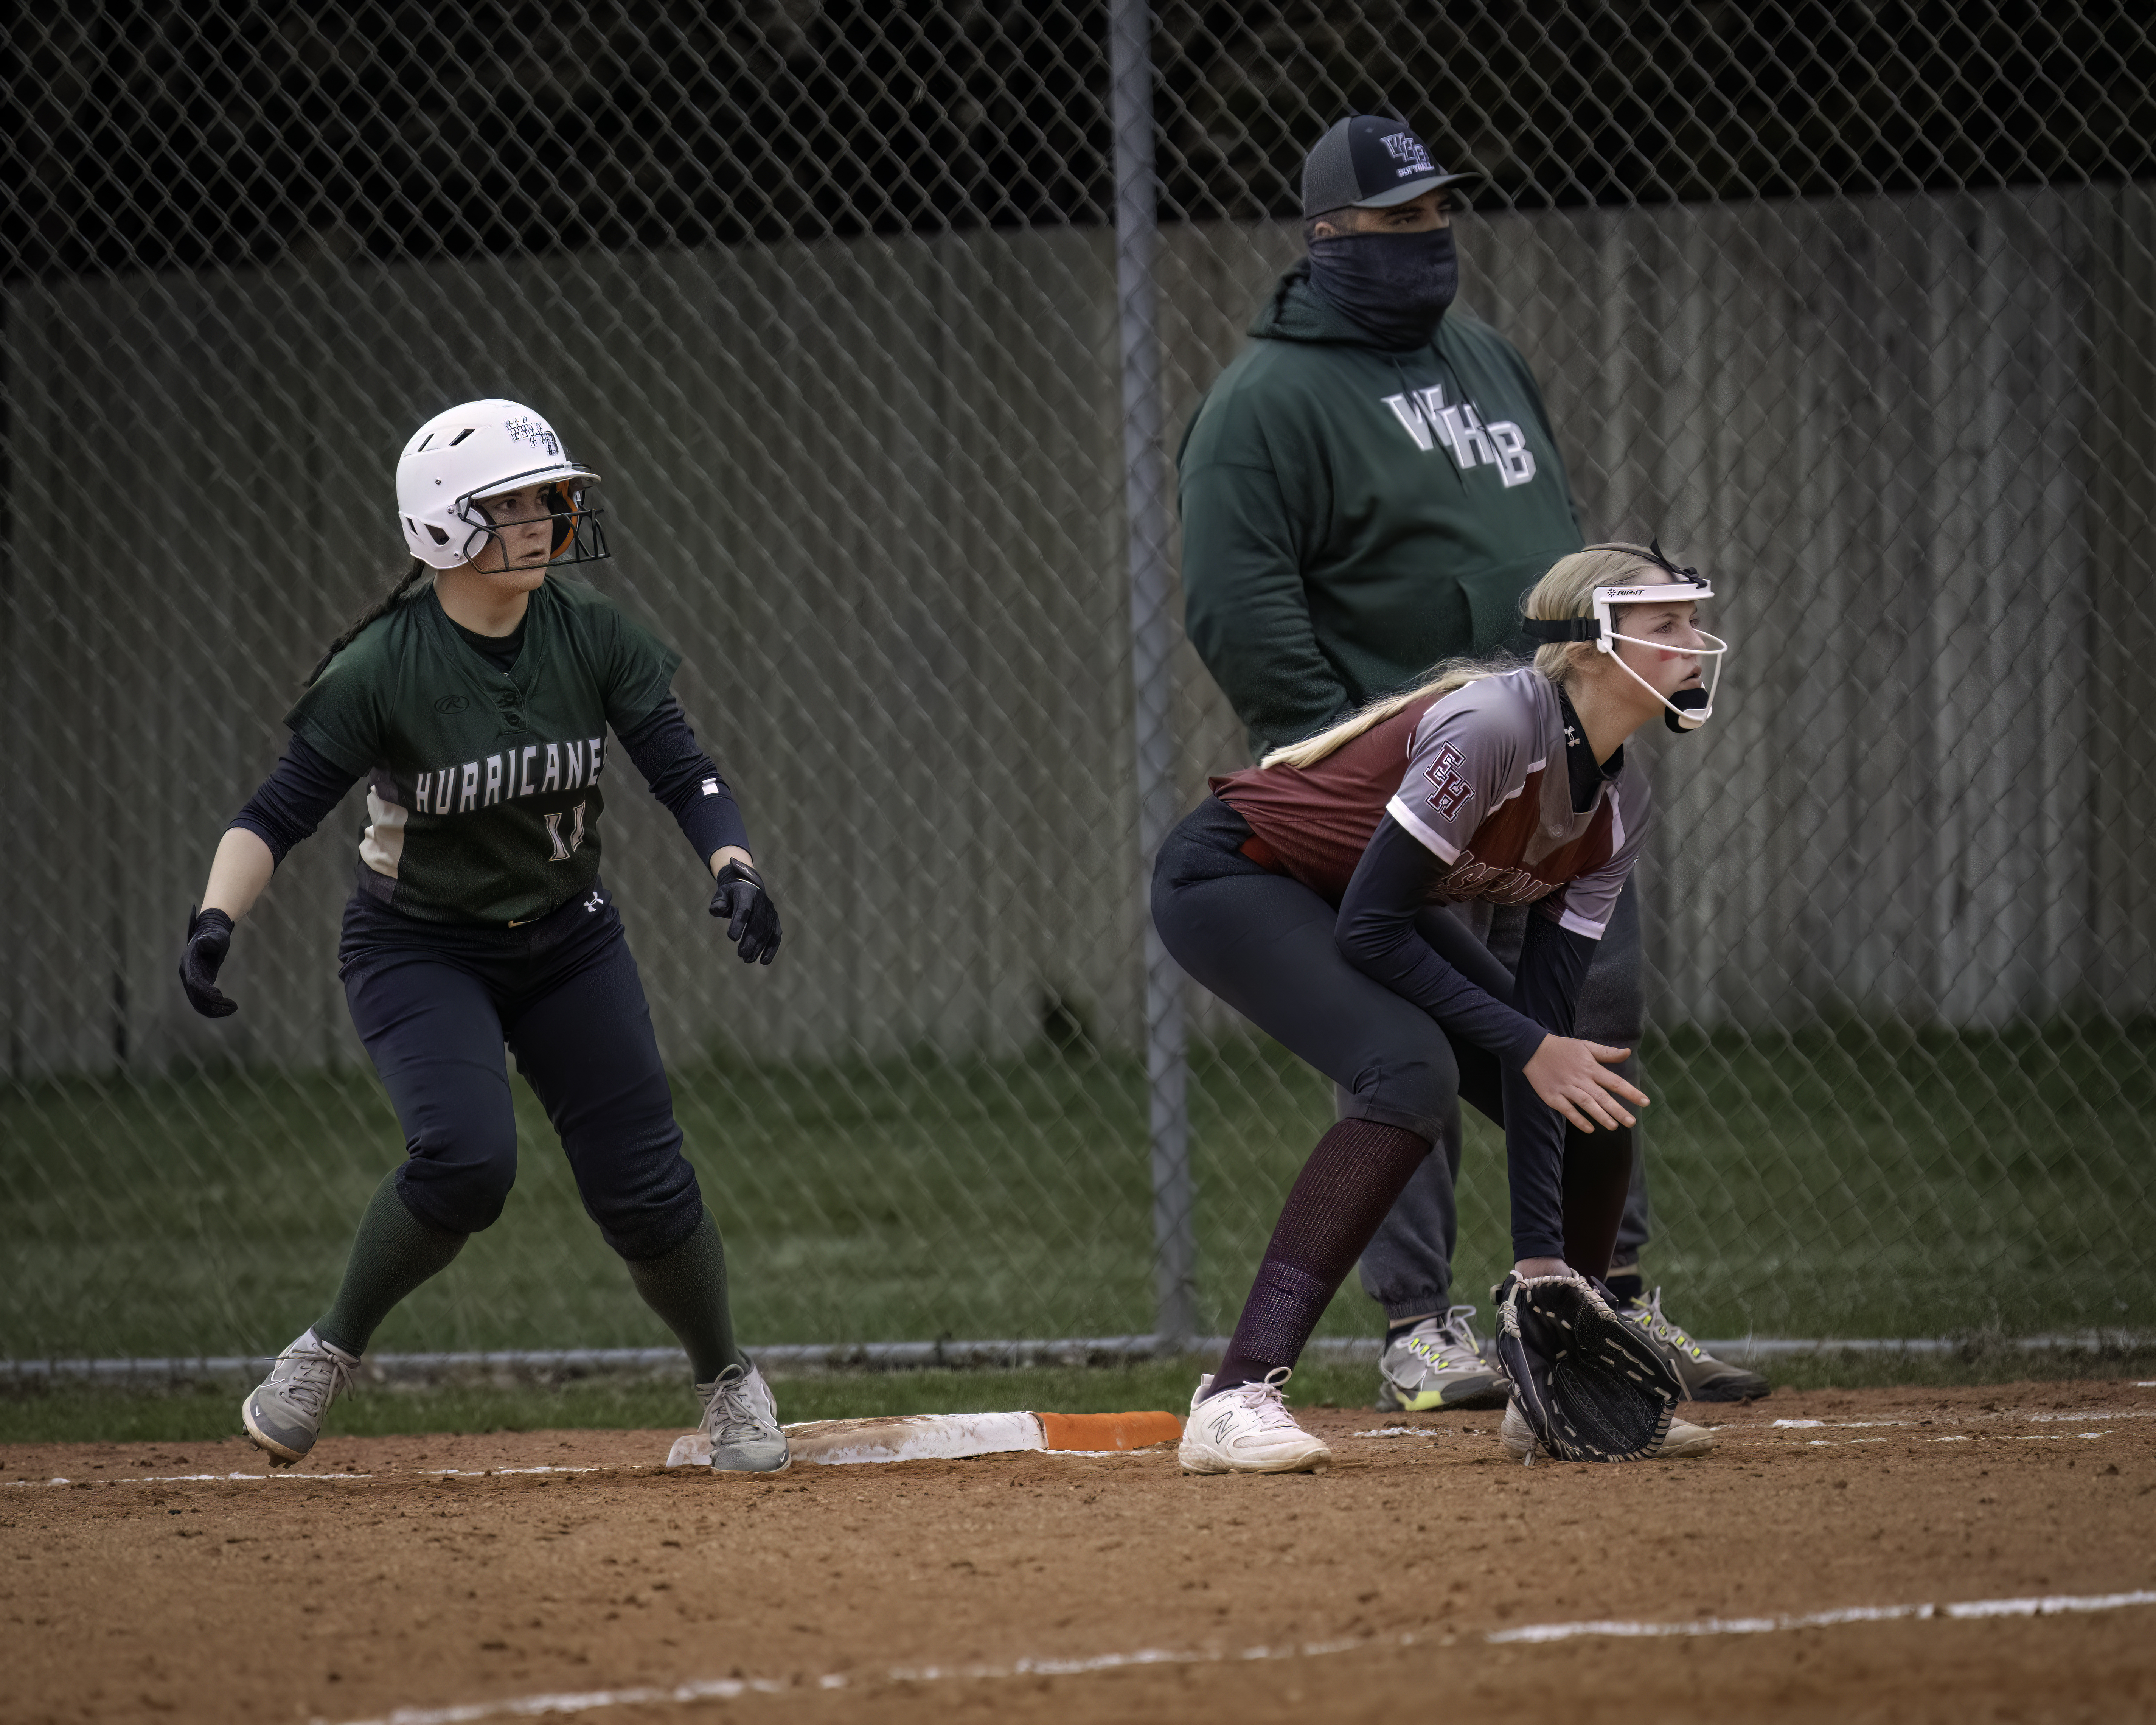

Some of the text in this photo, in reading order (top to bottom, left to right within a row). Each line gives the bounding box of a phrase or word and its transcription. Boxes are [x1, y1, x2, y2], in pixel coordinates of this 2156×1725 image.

[1380, 132, 1430, 163] WHB
[1380, 384, 1536, 488] WHB
[416, 737, 608, 815] HURRICANE
[1423, 740, 1475, 823] EH
